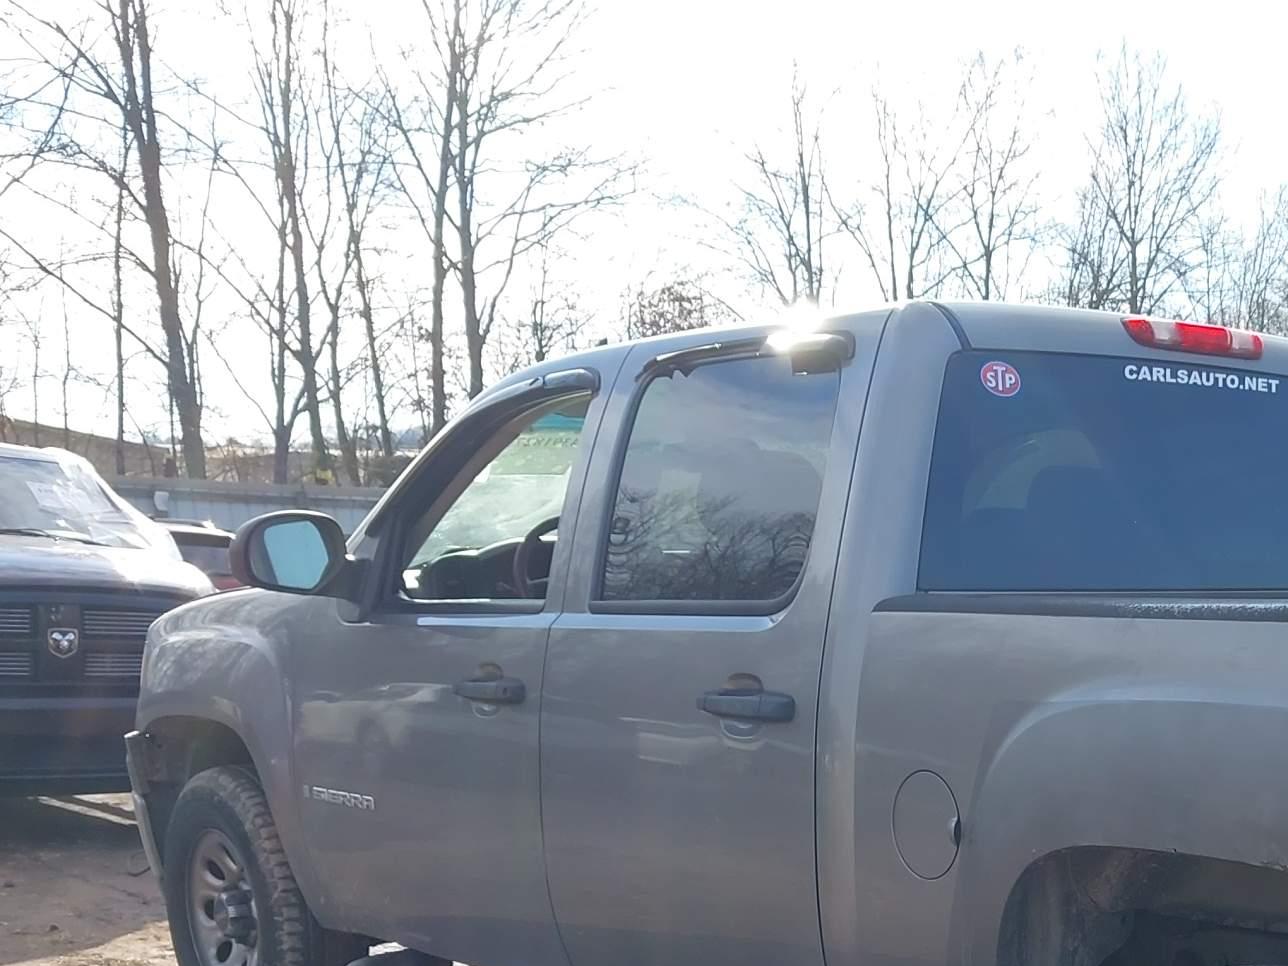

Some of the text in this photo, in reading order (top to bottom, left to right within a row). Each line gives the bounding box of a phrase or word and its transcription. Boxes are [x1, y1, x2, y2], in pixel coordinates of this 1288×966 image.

[986, 366, 1016, 391] STP
[1123, 365, 1279, 393] CARLSAUTO.NET
[312, 786, 375, 811] SIERRA
